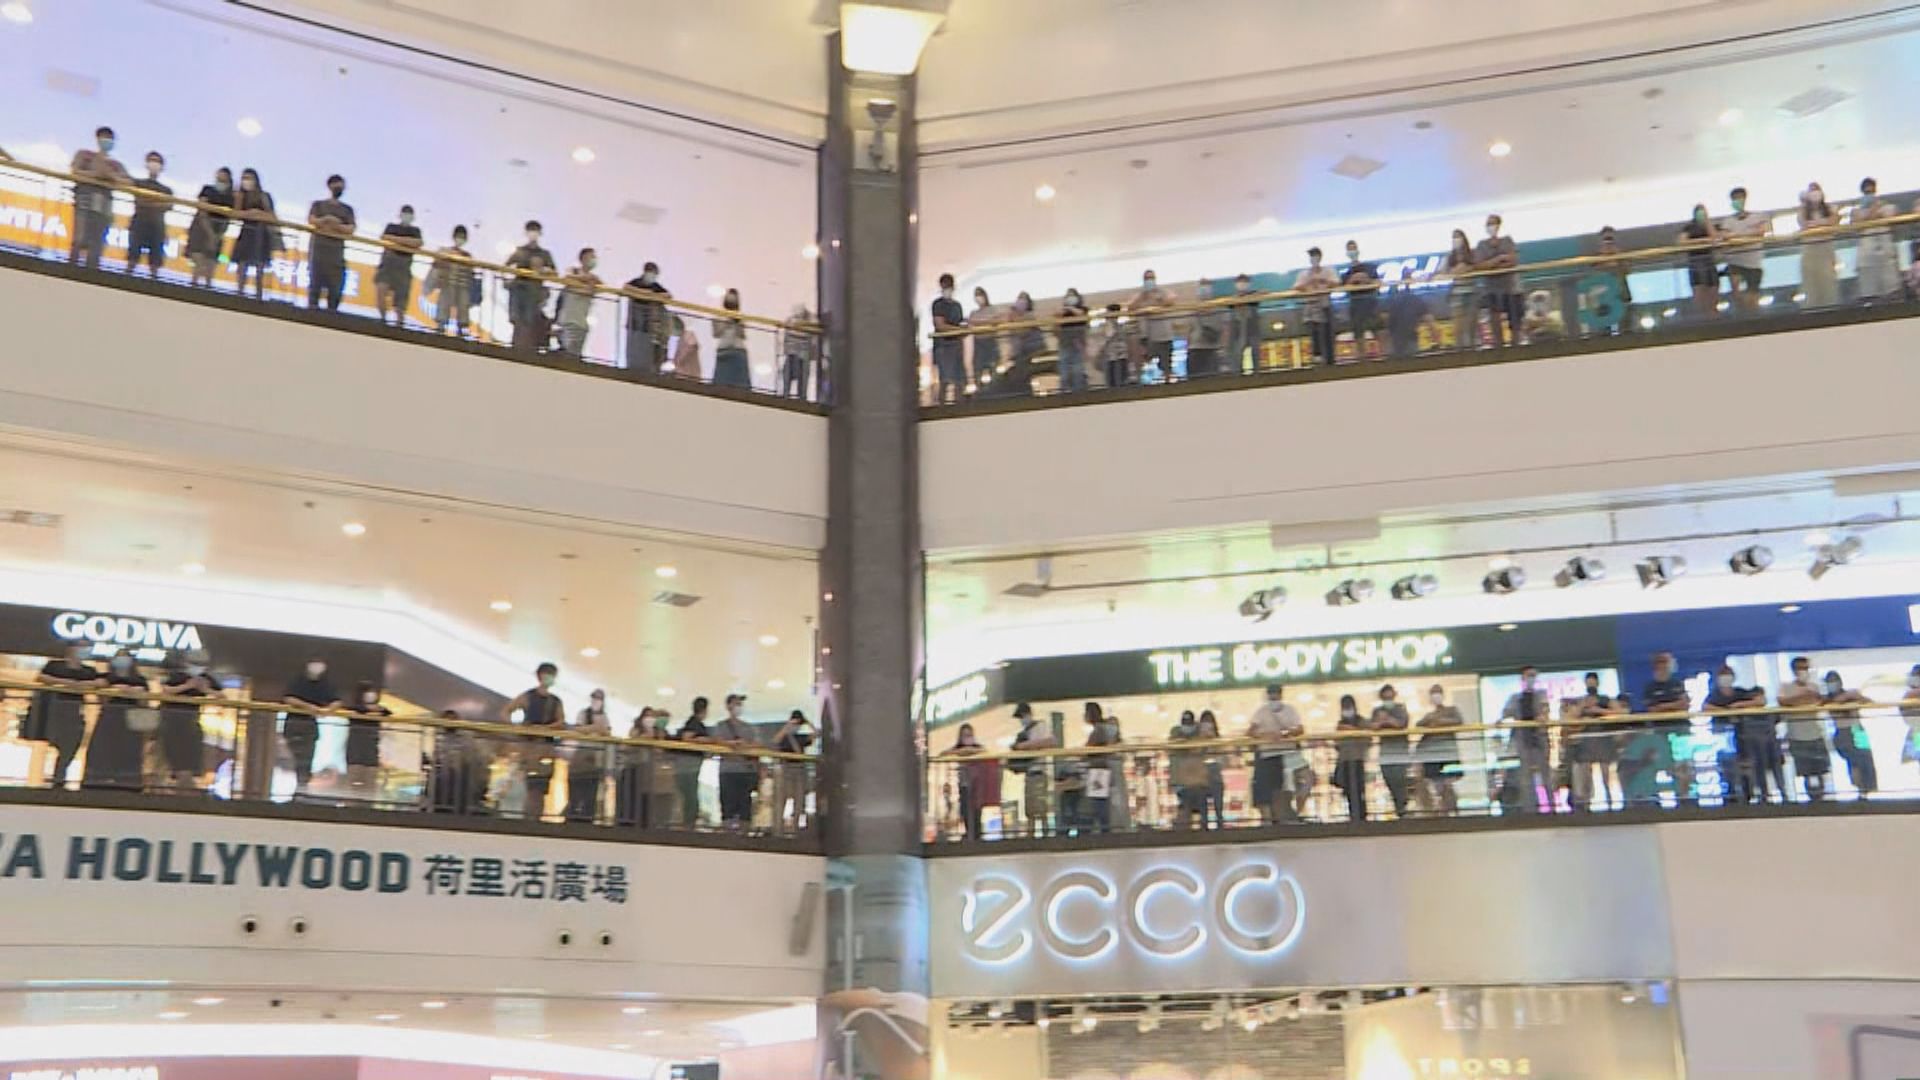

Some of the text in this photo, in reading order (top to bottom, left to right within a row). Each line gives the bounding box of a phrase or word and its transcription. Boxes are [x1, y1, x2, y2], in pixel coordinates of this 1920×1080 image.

[52, 611, 203, 650] GODIVA
[1148, 649, 1224, 684] THE
[1232, 642, 1339, 681] BODY
[0, 832, 409, 894] A HOLLYWOOD
[422, 853, 630, 904] 荷里活廣場
[961, 860, 1306, 967] ecco
